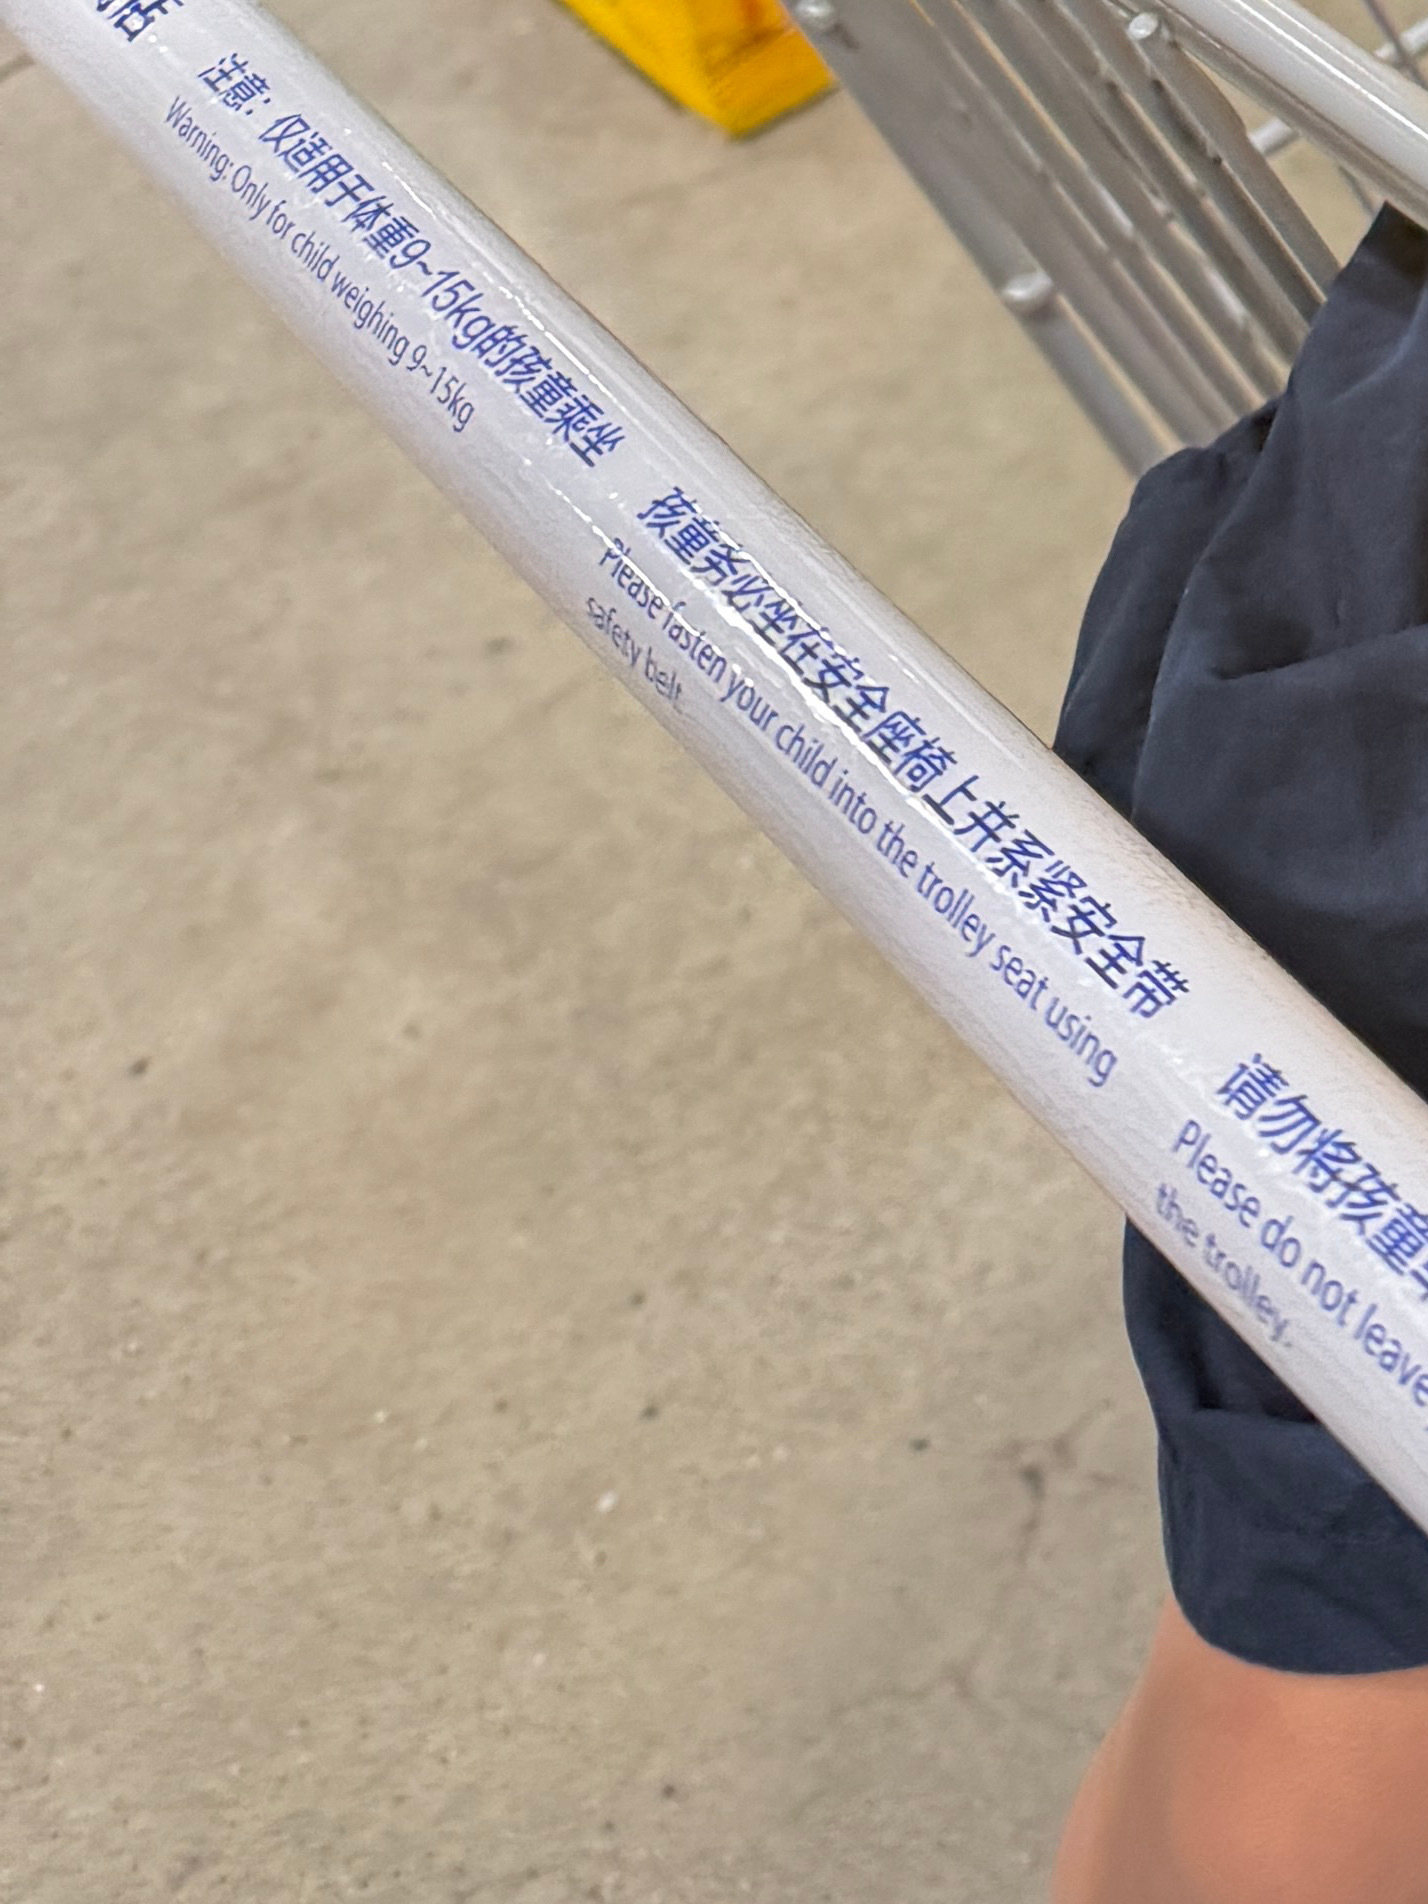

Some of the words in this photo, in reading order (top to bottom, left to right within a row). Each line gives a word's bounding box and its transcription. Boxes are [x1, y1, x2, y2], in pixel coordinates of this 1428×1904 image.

[164, 95, 234, 182] Warning:
[231, 164, 271, 221] Only
[266, 199, 296, 240] for
[291, 230, 340, 282] child
[331, 270, 409, 366] weighing
[406, 344, 475, 433] 9~15kg
[587, 596, 641, 667] safety
[599, 537, 665, 620] Please
[662, 601, 727, 683] fasten
[720, 672, 778, 732] your
[776, 723, 837, 788] child
[828, 769, 877, 834] into
[876, 820, 918, 878] the
[917, 862, 996, 958] trolley
[990, 944, 1049, 1011] seat
[1043, 996, 1118, 1088] using
[1155, 1182, 1199, 1249] the
[1172, 1118, 1261, 1228] Please
[1261, 1214, 1301, 1268] do
[1301, 1259, 1359, 1327] not
